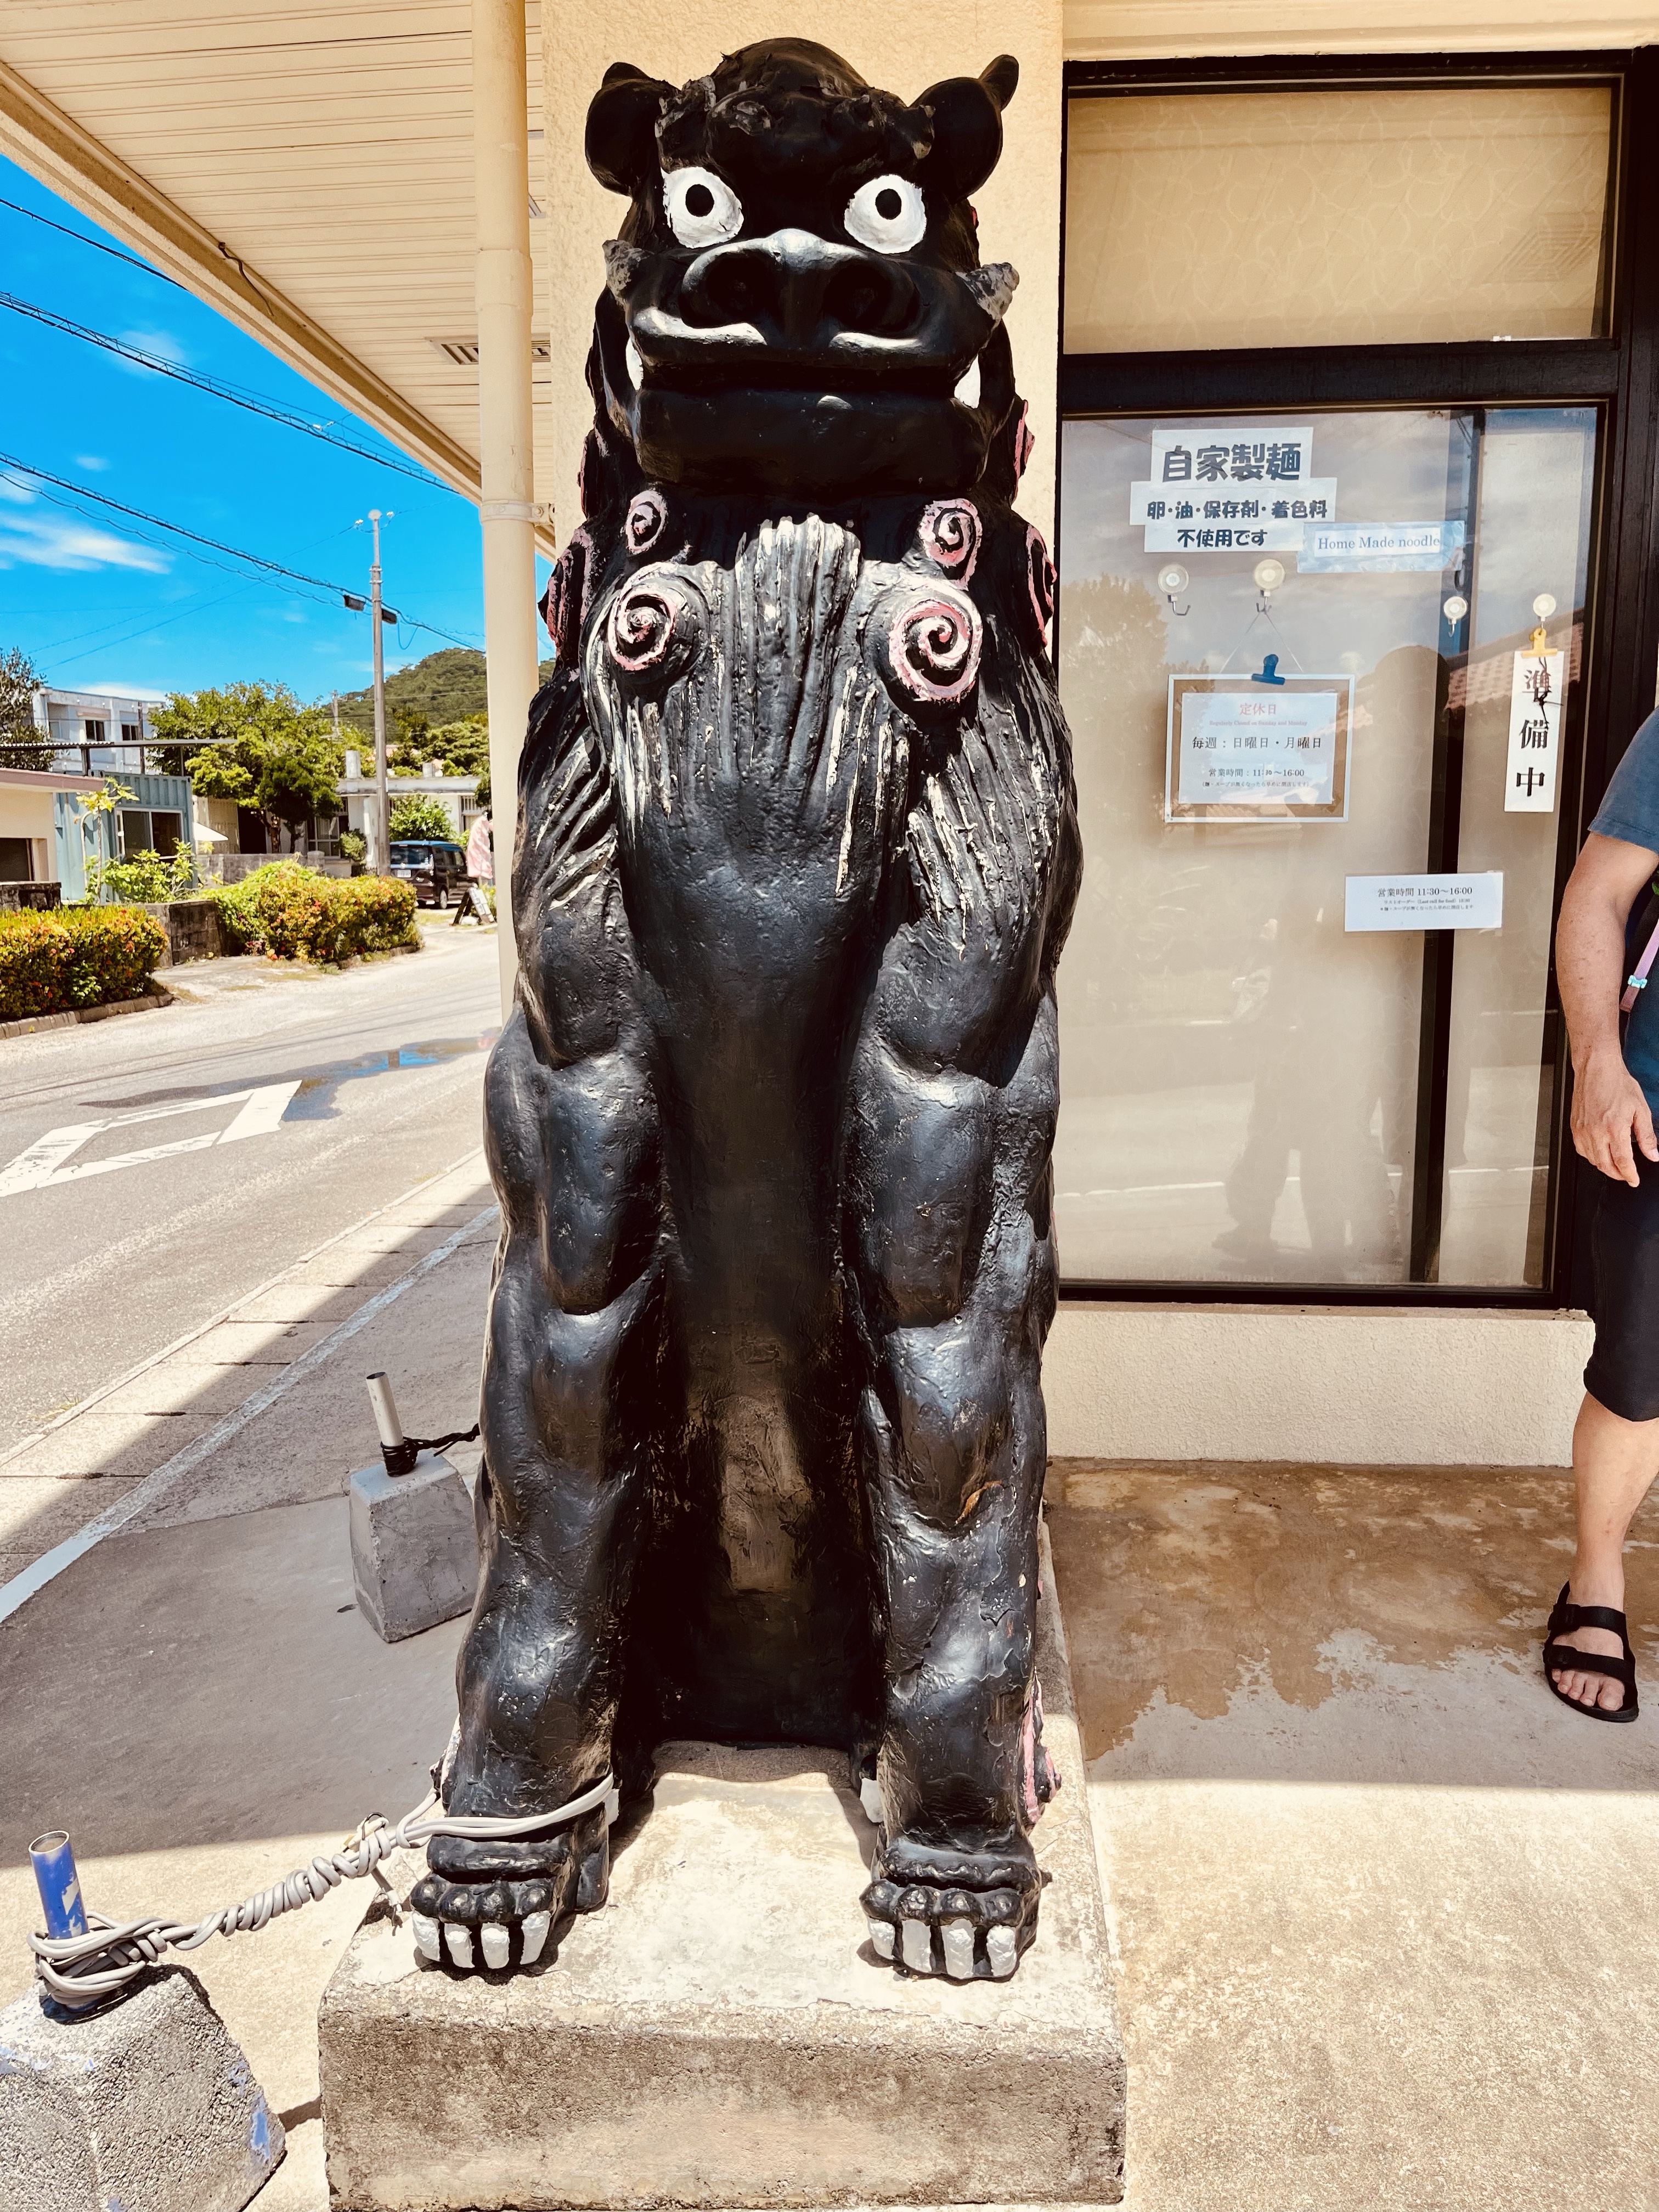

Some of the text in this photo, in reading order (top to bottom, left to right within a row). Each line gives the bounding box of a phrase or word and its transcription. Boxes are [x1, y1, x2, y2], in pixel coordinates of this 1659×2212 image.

[1163, 443, 1301, 483] 自家製麺
[1177, 529, 1268, 548] 不使用です
[1318, 535, 1440, 550] Home Made noodle
[1239, 703, 1277, 716] 定休日
[1516, 670, 1551, 797] 準備中
[1378, 888, 1414, 898] 営業時間
